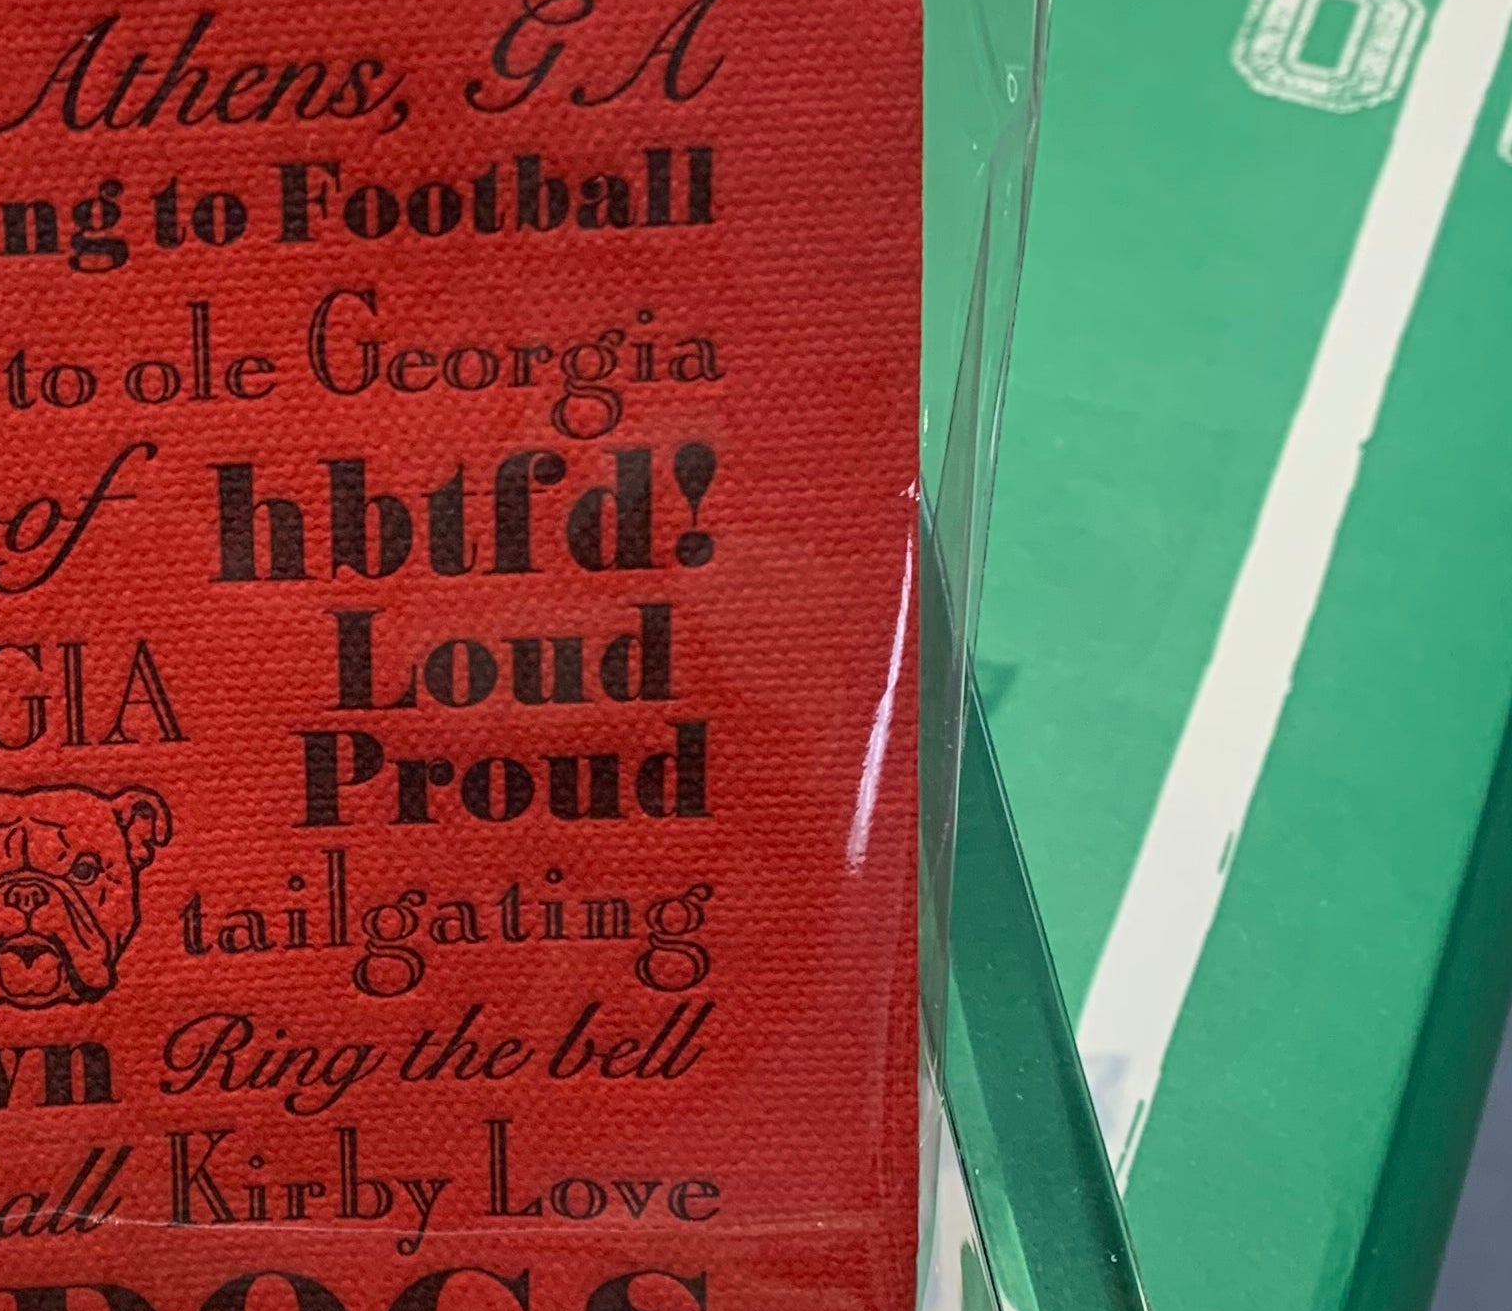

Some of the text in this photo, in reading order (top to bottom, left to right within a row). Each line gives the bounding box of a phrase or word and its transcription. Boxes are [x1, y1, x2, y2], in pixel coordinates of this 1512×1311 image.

[152, 176, 250, 248] to
[276, 146, 716, 244] Football
[2, 346, 98, 412] to
[122, 300, 278, 406] ole
[306, 289, 728, 442] Georgia
[204, 442, 720, 586] hbtfd!
[322, 602, 678, 714] Loud
[290, 720, 716, 830] Proud
[178, 846, 716, 1000] tailgating
[158, 1000, 718, 1118] Ring the bell
[164, 1118, 724, 1258] Kirby Love
